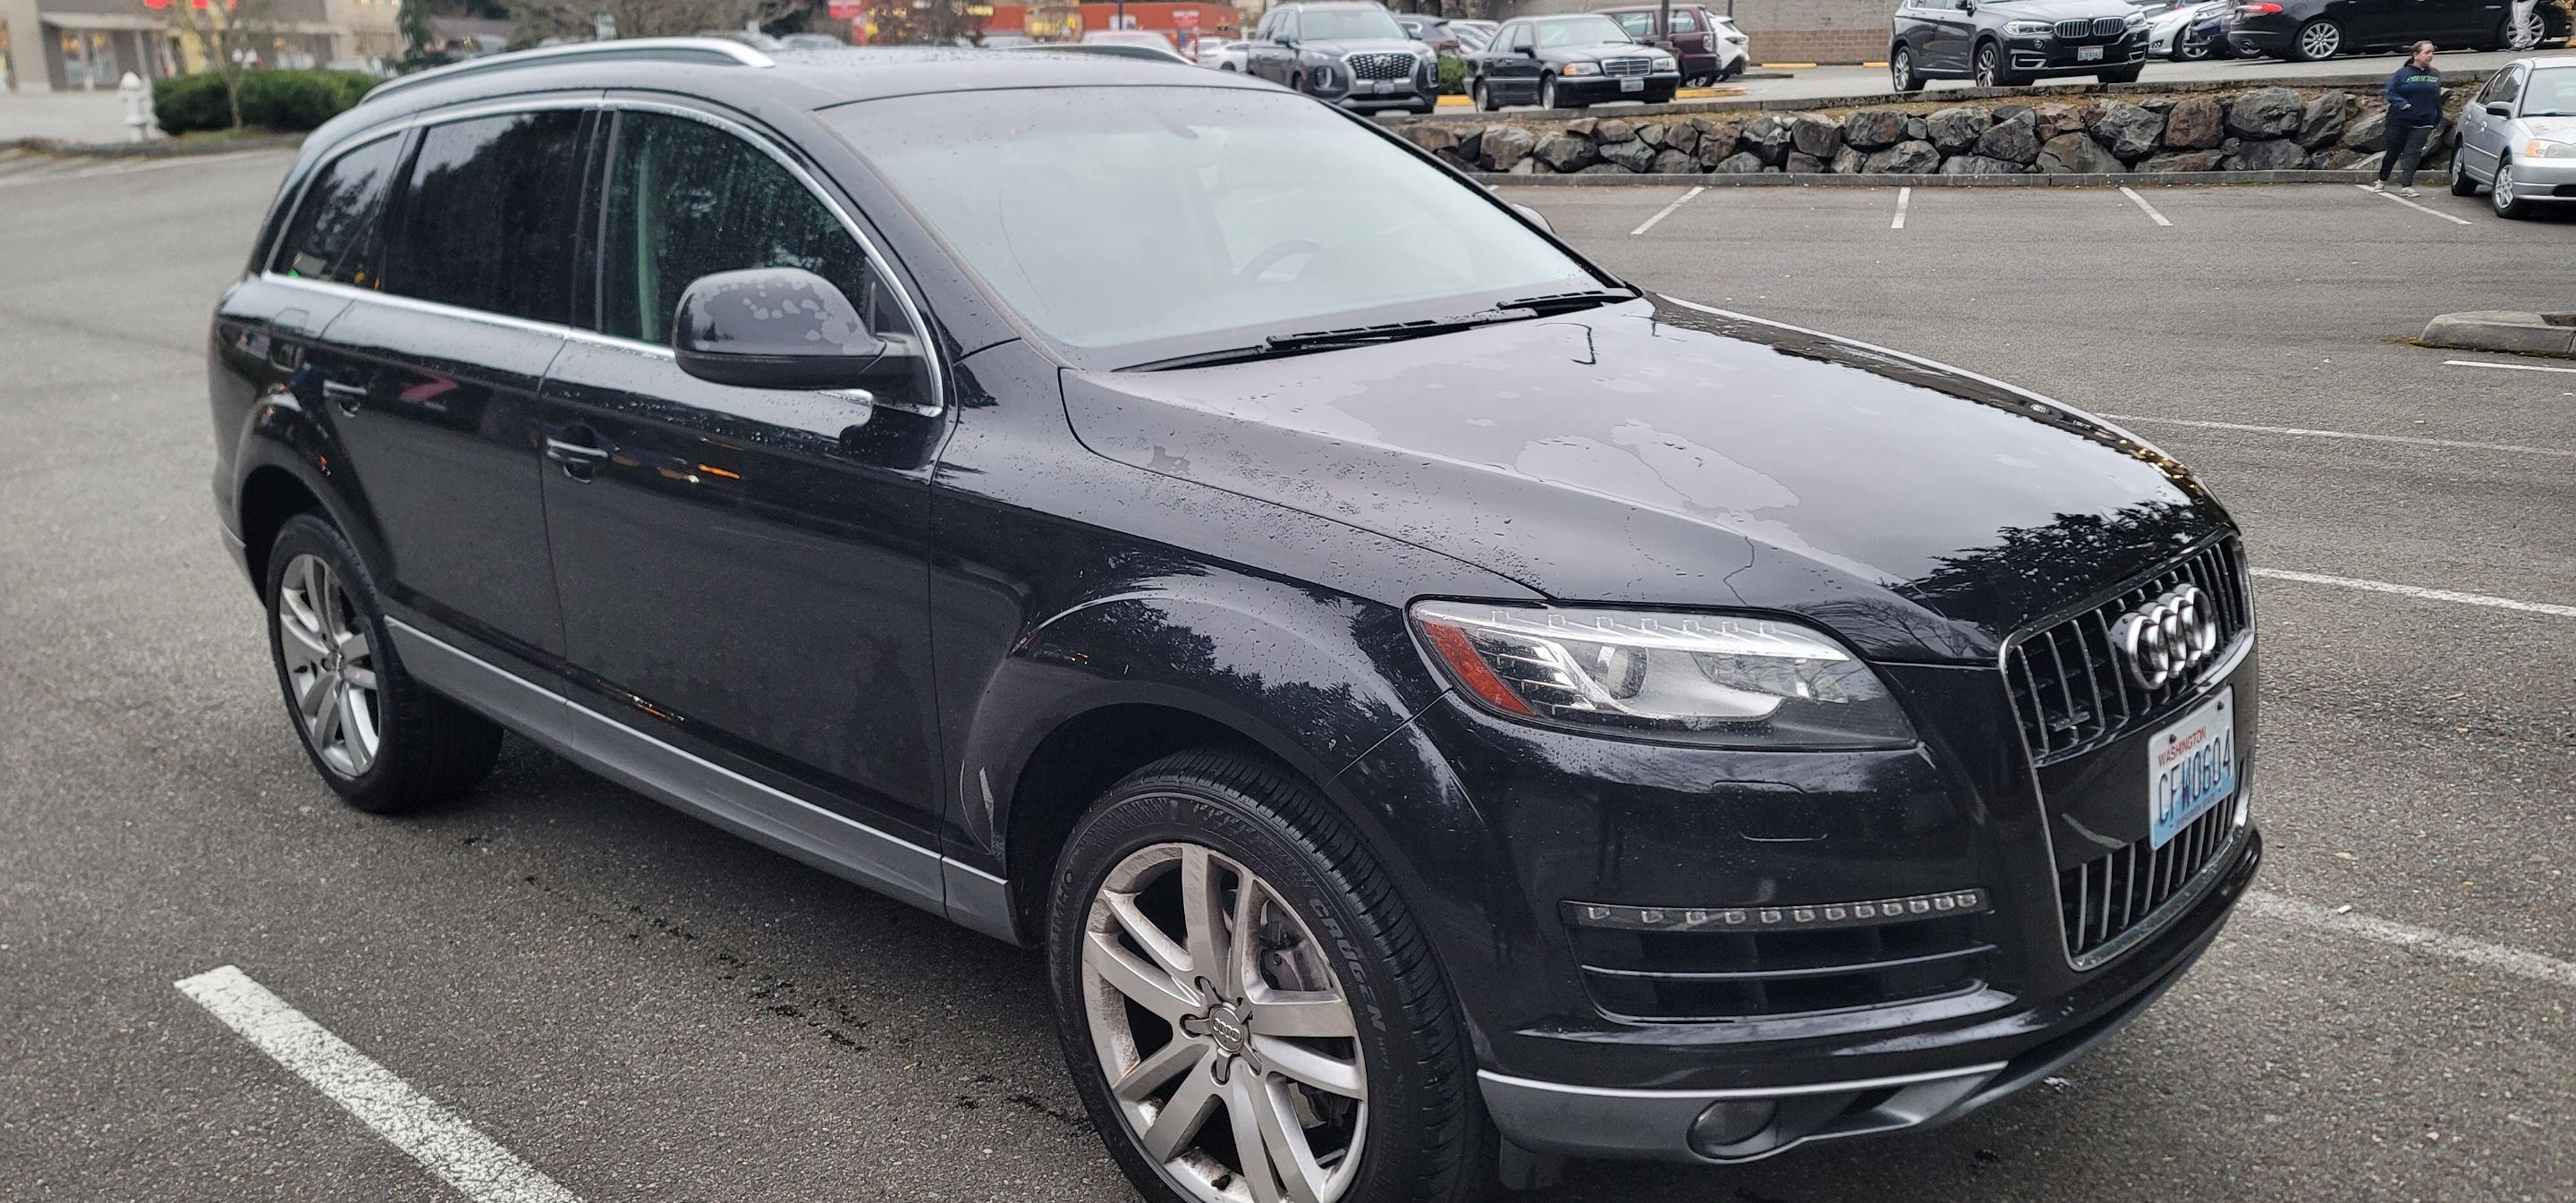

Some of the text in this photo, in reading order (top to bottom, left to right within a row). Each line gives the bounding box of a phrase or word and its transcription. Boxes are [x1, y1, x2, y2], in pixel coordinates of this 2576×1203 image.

[2157, 727, 2207, 767] WASHINGTON
[2159, 728, 2231, 825] CFW0604
[1309, 897, 1386, 1031] CRUGEN
